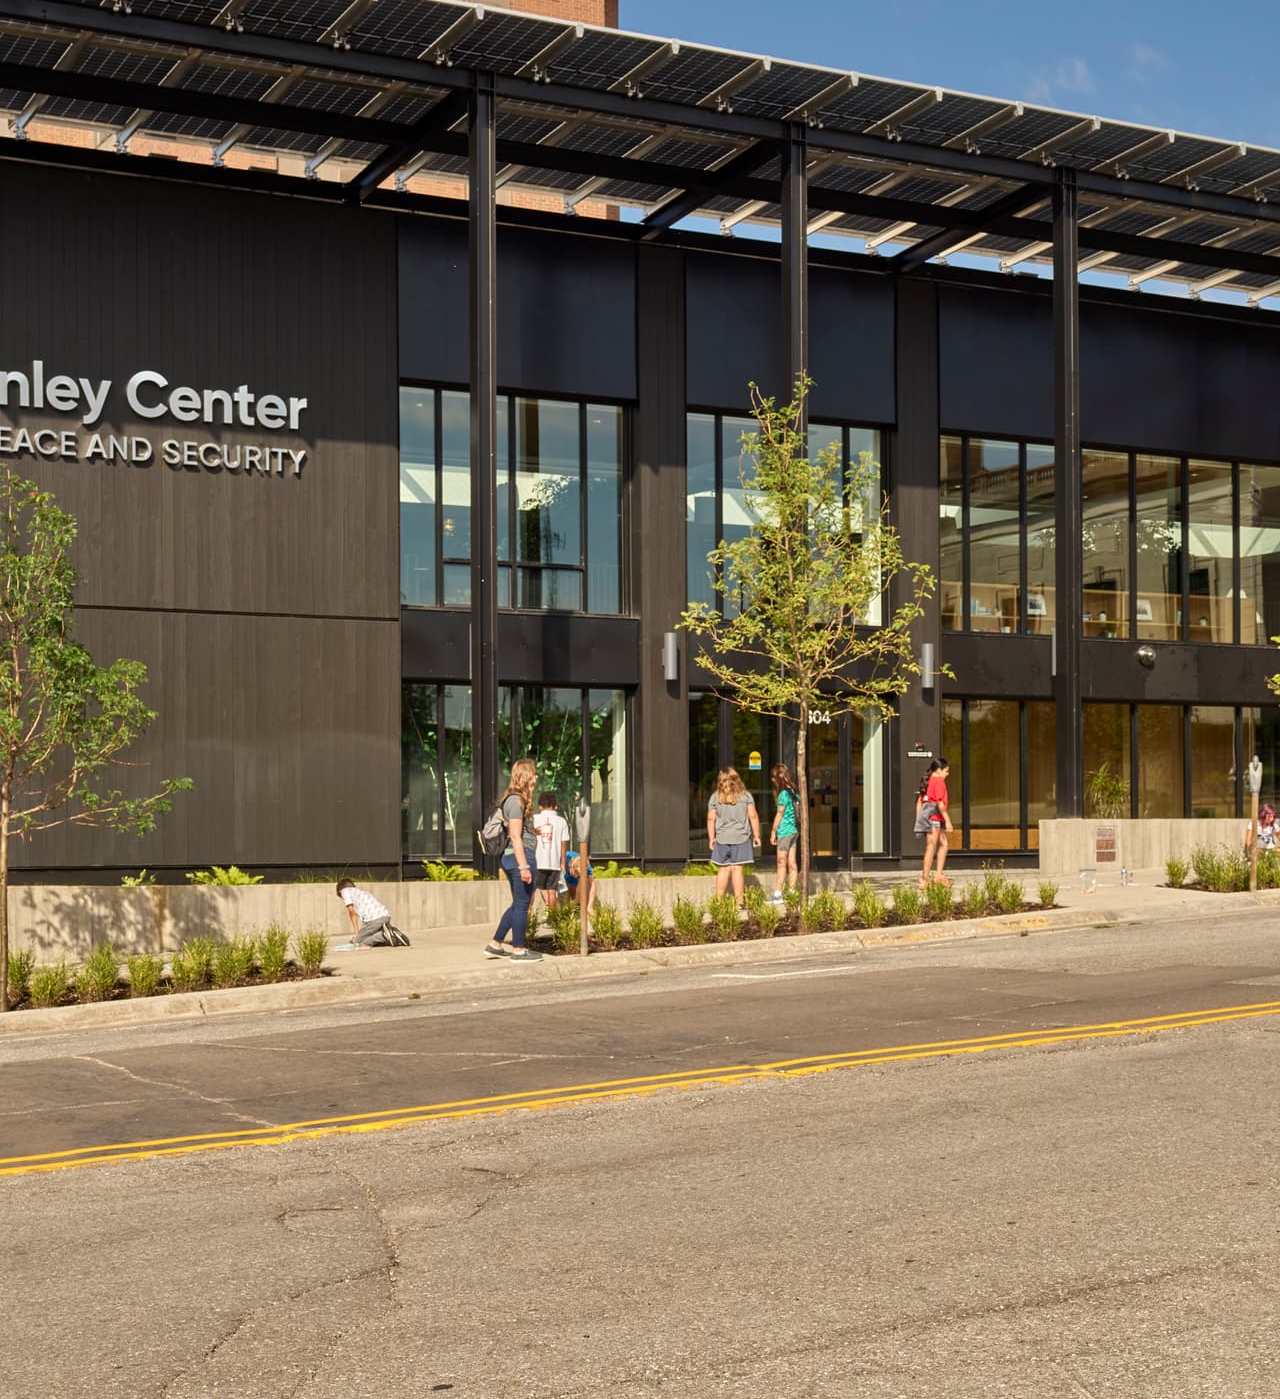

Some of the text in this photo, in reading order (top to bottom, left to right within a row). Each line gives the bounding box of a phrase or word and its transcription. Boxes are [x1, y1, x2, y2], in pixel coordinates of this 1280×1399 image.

[126, 370, 308, 430] Center
[85, 434, 153, 463] AND
[162, 439, 306, 474] SECURITY
